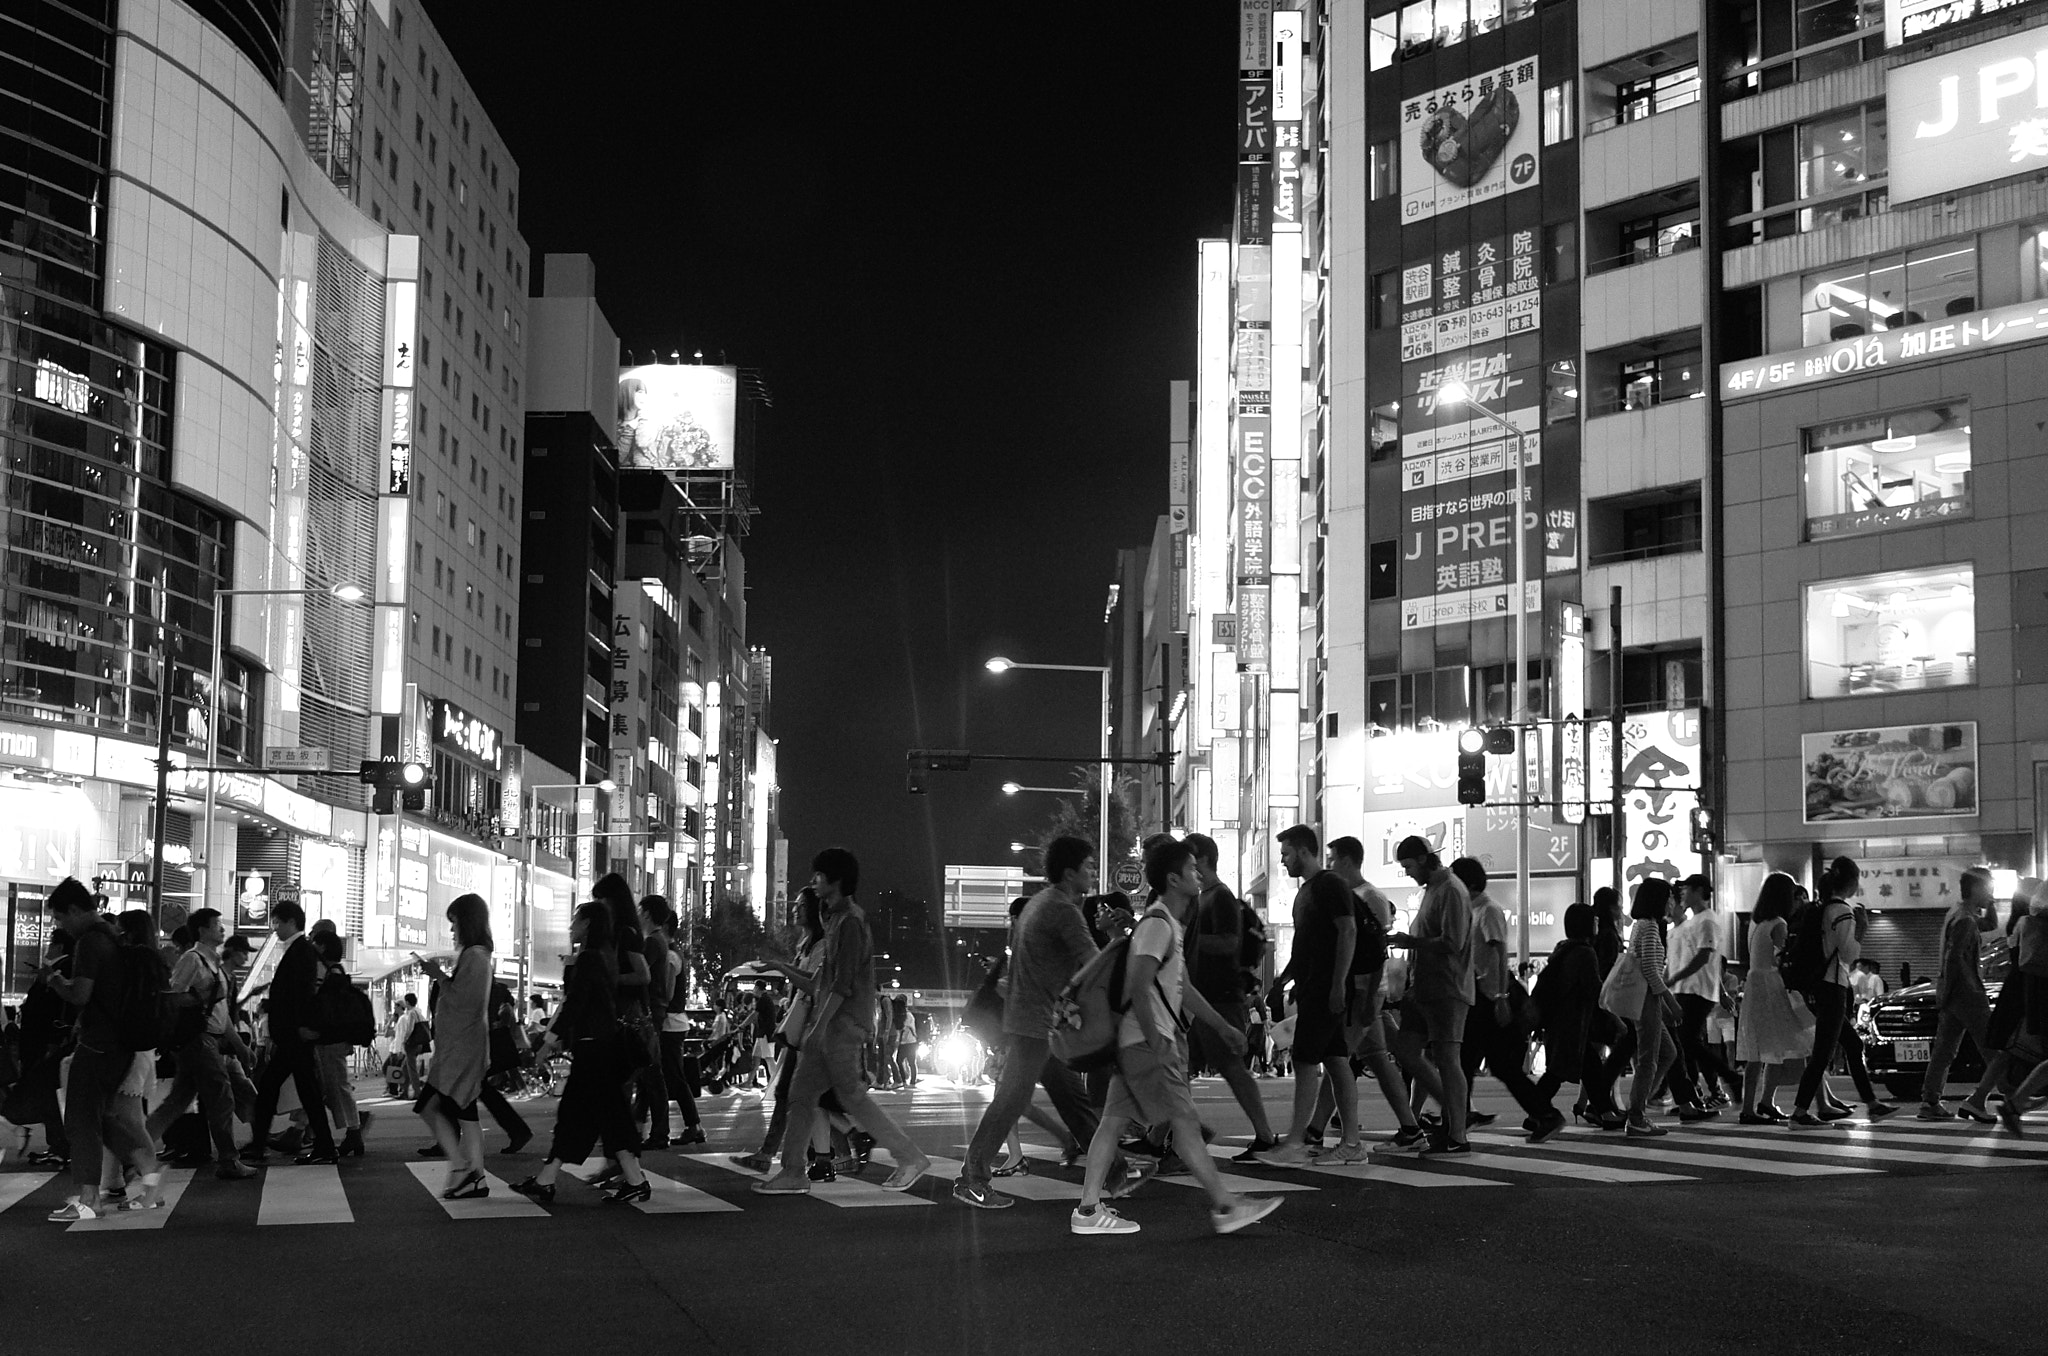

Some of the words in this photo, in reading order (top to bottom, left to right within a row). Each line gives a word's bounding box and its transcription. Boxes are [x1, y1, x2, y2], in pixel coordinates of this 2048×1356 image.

[1404, 62, 1534, 122] 売るなら最高額
[1915, 75, 1959, 138] J
[1978, 48, 2048, 124] P
[1244, 85, 1267, 148] アビバ
[1514, 160, 1533, 177] 7F
[1442, 230, 1532, 274] 鍼灸院
[1405, 267, 1430, 284] 渋谷
[1442, 256, 1532, 299] 整骨院
[1404, 282, 1429, 302] 駅前
[1471, 297, 1539, 324] 03-6434-1254
[1414, 341, 1433, 355] 6階
[1417, 352, 1512, 393] 近畿日本
[1508, 437, 1538, 453] 当ル
[1404, 458, 1432, 472] 入口この下
[1441, 454, 1501, 475] 渋谷営業所
[1411, 486, 1532, 522] 目指すなら世界の頂点
[1404, 531, 1422, 560] J
[1437, 512, 1539, 555] PREP
[1437, 557, 1504, 592] 英語塾
[1563, 607, 1582, 634] 1F
[1671, 712, 1699, 738] 1F
[272, 750, 323, 761] 宮益坂下
[1527, 732, 1539, 792] 右車専用
[1551, 836, 1569, 852] 2F
[1904, 1049, 1929, 1061] 13-08
